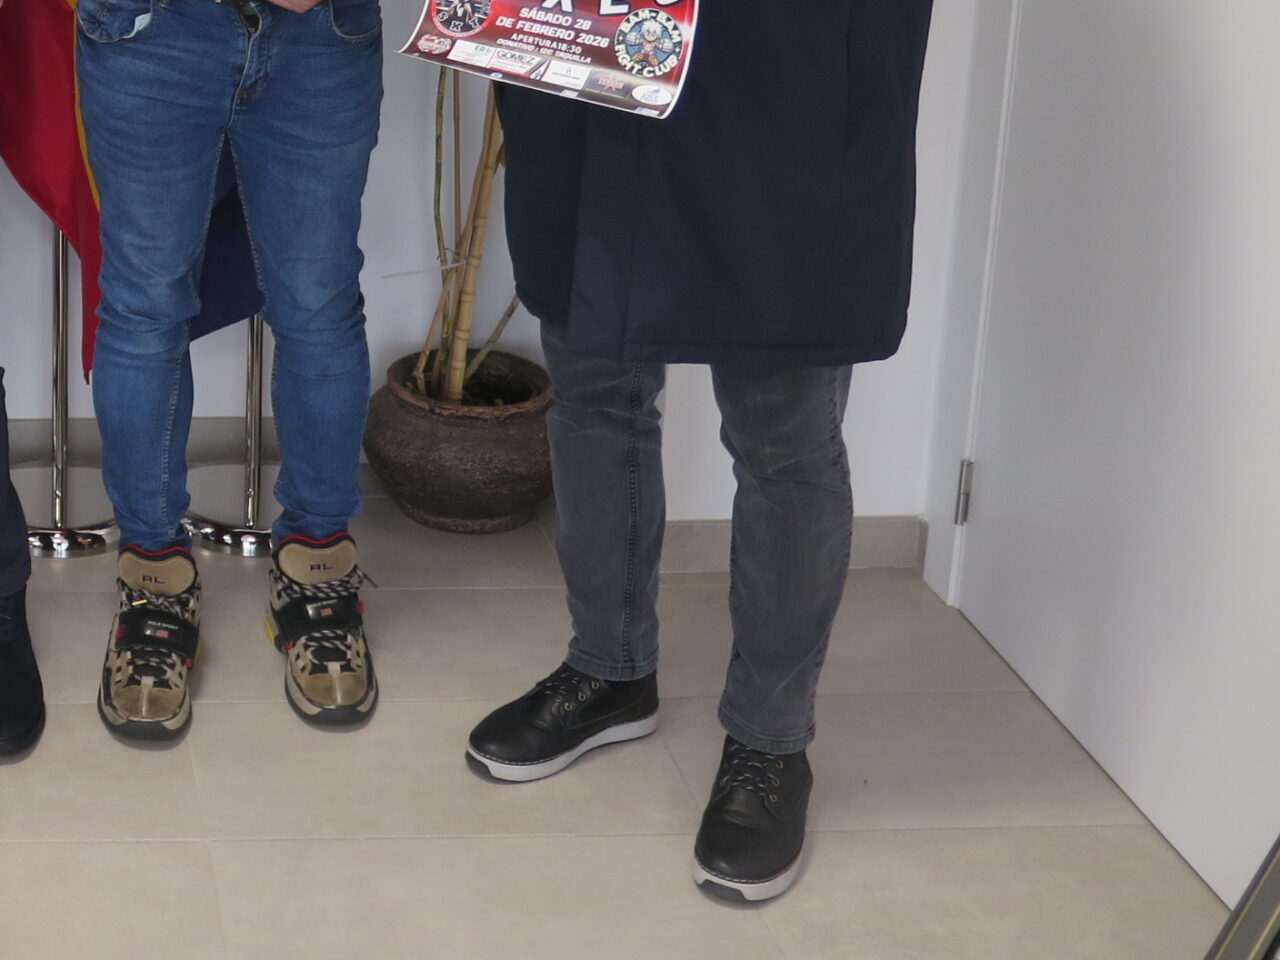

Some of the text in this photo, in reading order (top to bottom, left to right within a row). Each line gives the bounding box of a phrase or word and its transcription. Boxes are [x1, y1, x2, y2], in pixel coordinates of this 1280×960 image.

[438, 12, 480, 32] SKT
[496, 16, 515, 28] DE
[521, 20, 575, 41] FEBRERO
[578, 33, 610, 48] 2026
[519, 7, 592, 31] SÁBADO 28
[619, 9, 681, 42] BAM-BAM
[496, 38, 535, 52] DONATIVO
[554, 49, 591, 64] TAQUILLA
[615, 44, 679, 78] FIGHT CLUB
